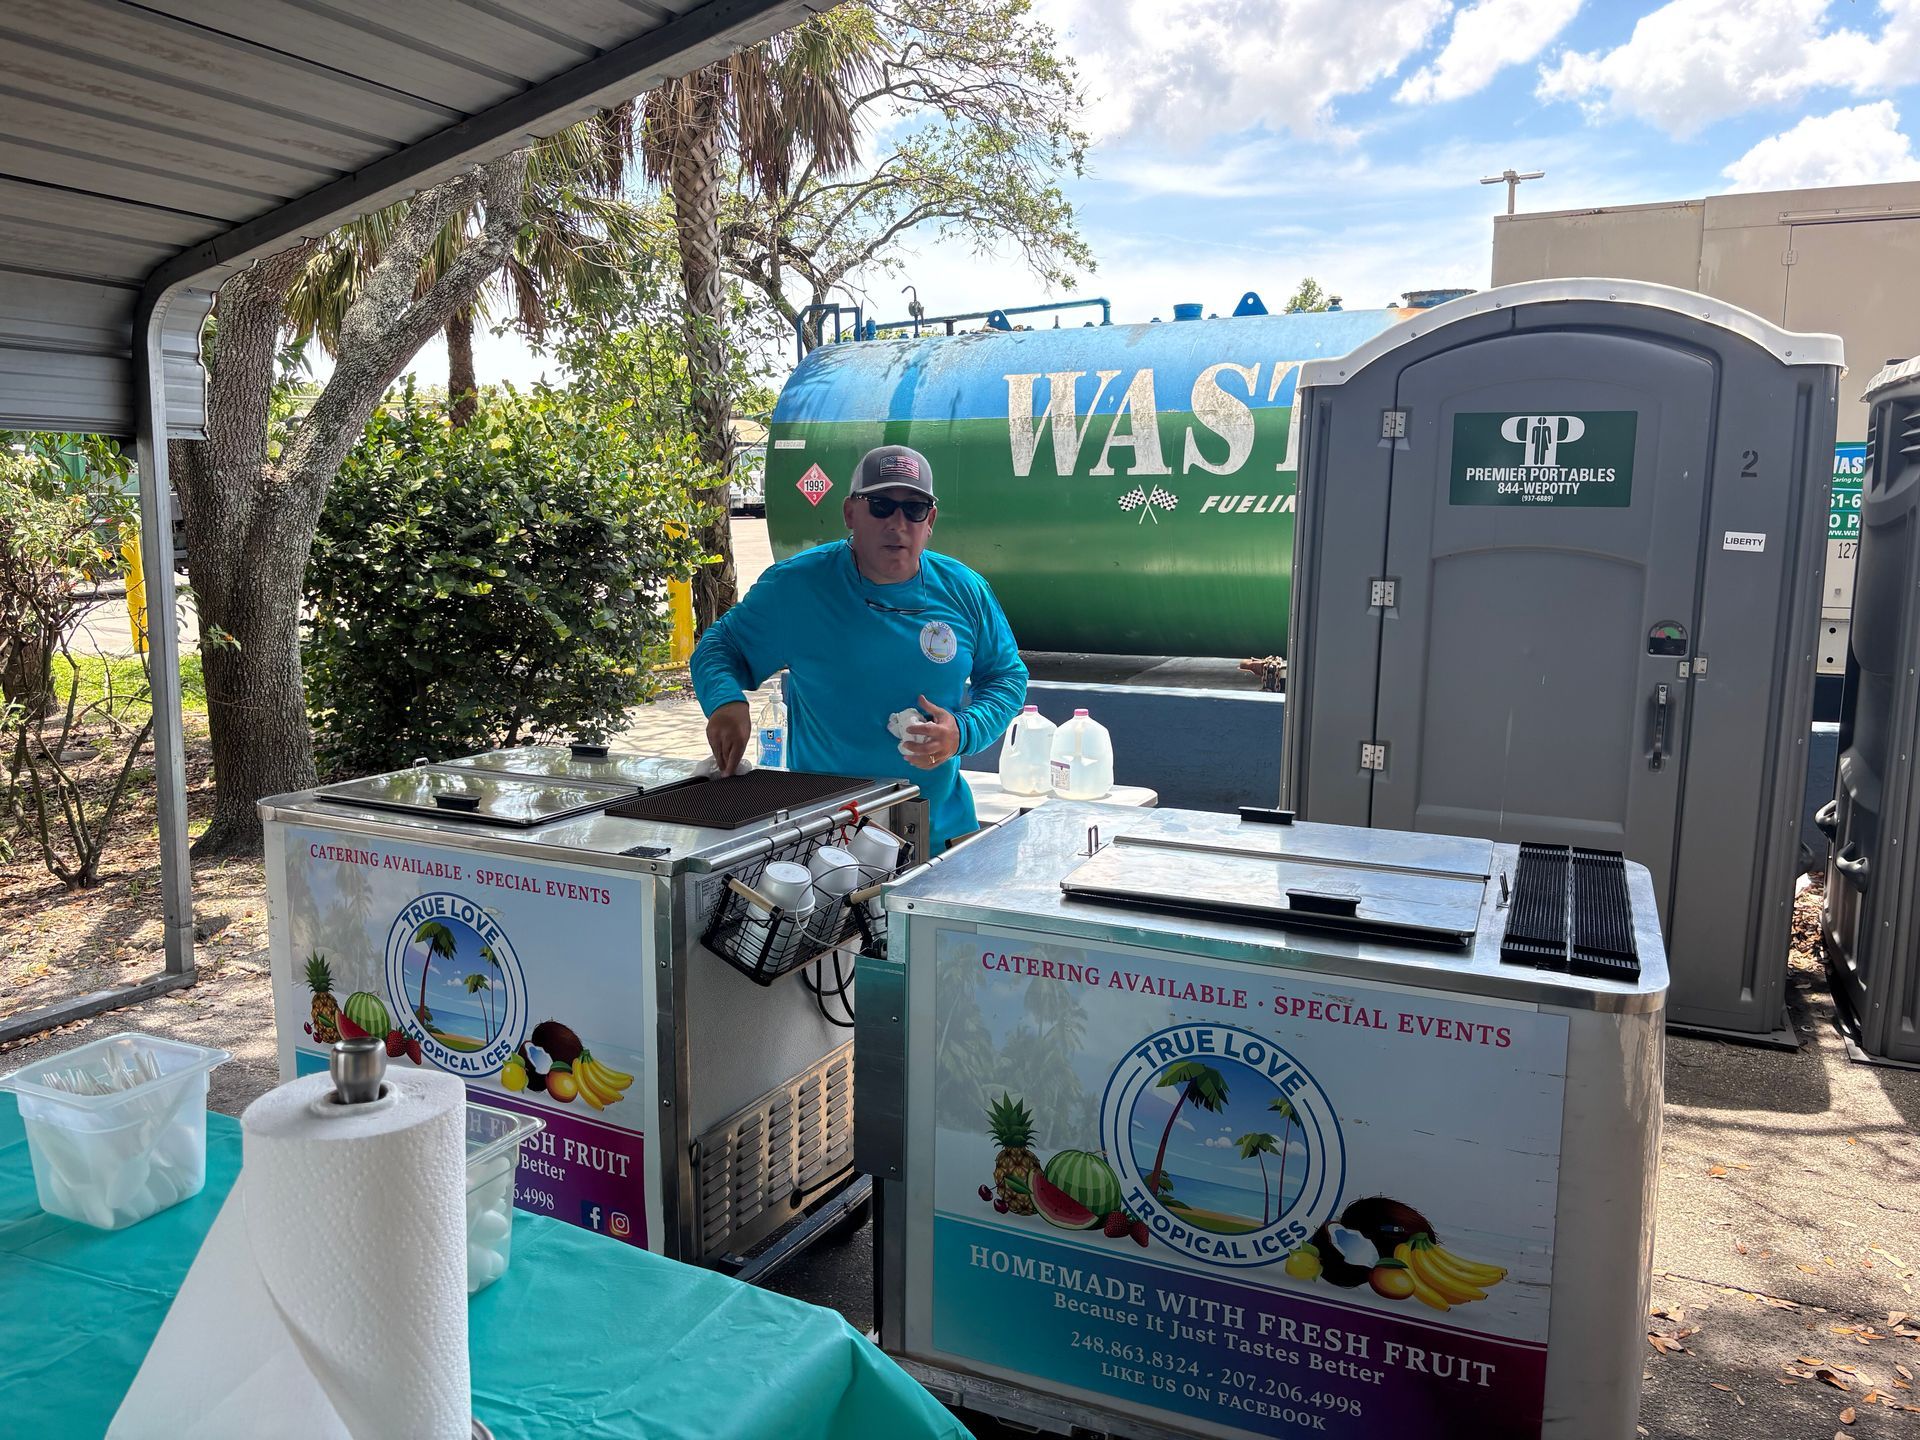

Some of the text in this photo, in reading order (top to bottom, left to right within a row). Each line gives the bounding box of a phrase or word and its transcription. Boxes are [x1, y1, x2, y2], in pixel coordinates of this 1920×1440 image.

[805, 480, 824, 491] 1993
[1466, 467, 1616, 482] PREMIER PORTABLES
[1497, 482, 1580, 495] 844-WEPOTTY
[1741, 450, 1758, 478] 2
[1521, 495, 1554, 503] (937-6889)
[1725, 537, 1764, 546] LIBERTY
[310, 844, 611, 905] CATERING AVAILABLE SPECIAL EVENTS
[402, 897, 500, 946] TRUE LOVE
[982, 952, 1511, 1048] CATERING AVAILABLE SPECIAL EVENTS
[408, 1019, 511, 1071] TROPICAL ICES
[1136, 1029, 1307, 1097] TRUE LOVE
[521, 1153, 566, 1181] Better
[563, 1137, 630, 1178] FRUIT
[1127, 1186, 1308, 1259] TROPICAL ICES
[969, 1244, 1496, 1387] HOMEMADE WITH FRESH FRUIT
[1053, 1292, 1385, 1385] Because It Just Tastes Better
[1071, 1331, 1199, 1377] 248.863.8324
[1221, 1368, 1362, 1418] 207.206.4998
[1101, 1362, 1327, 1431] LIKE US ON FACEBOOK
